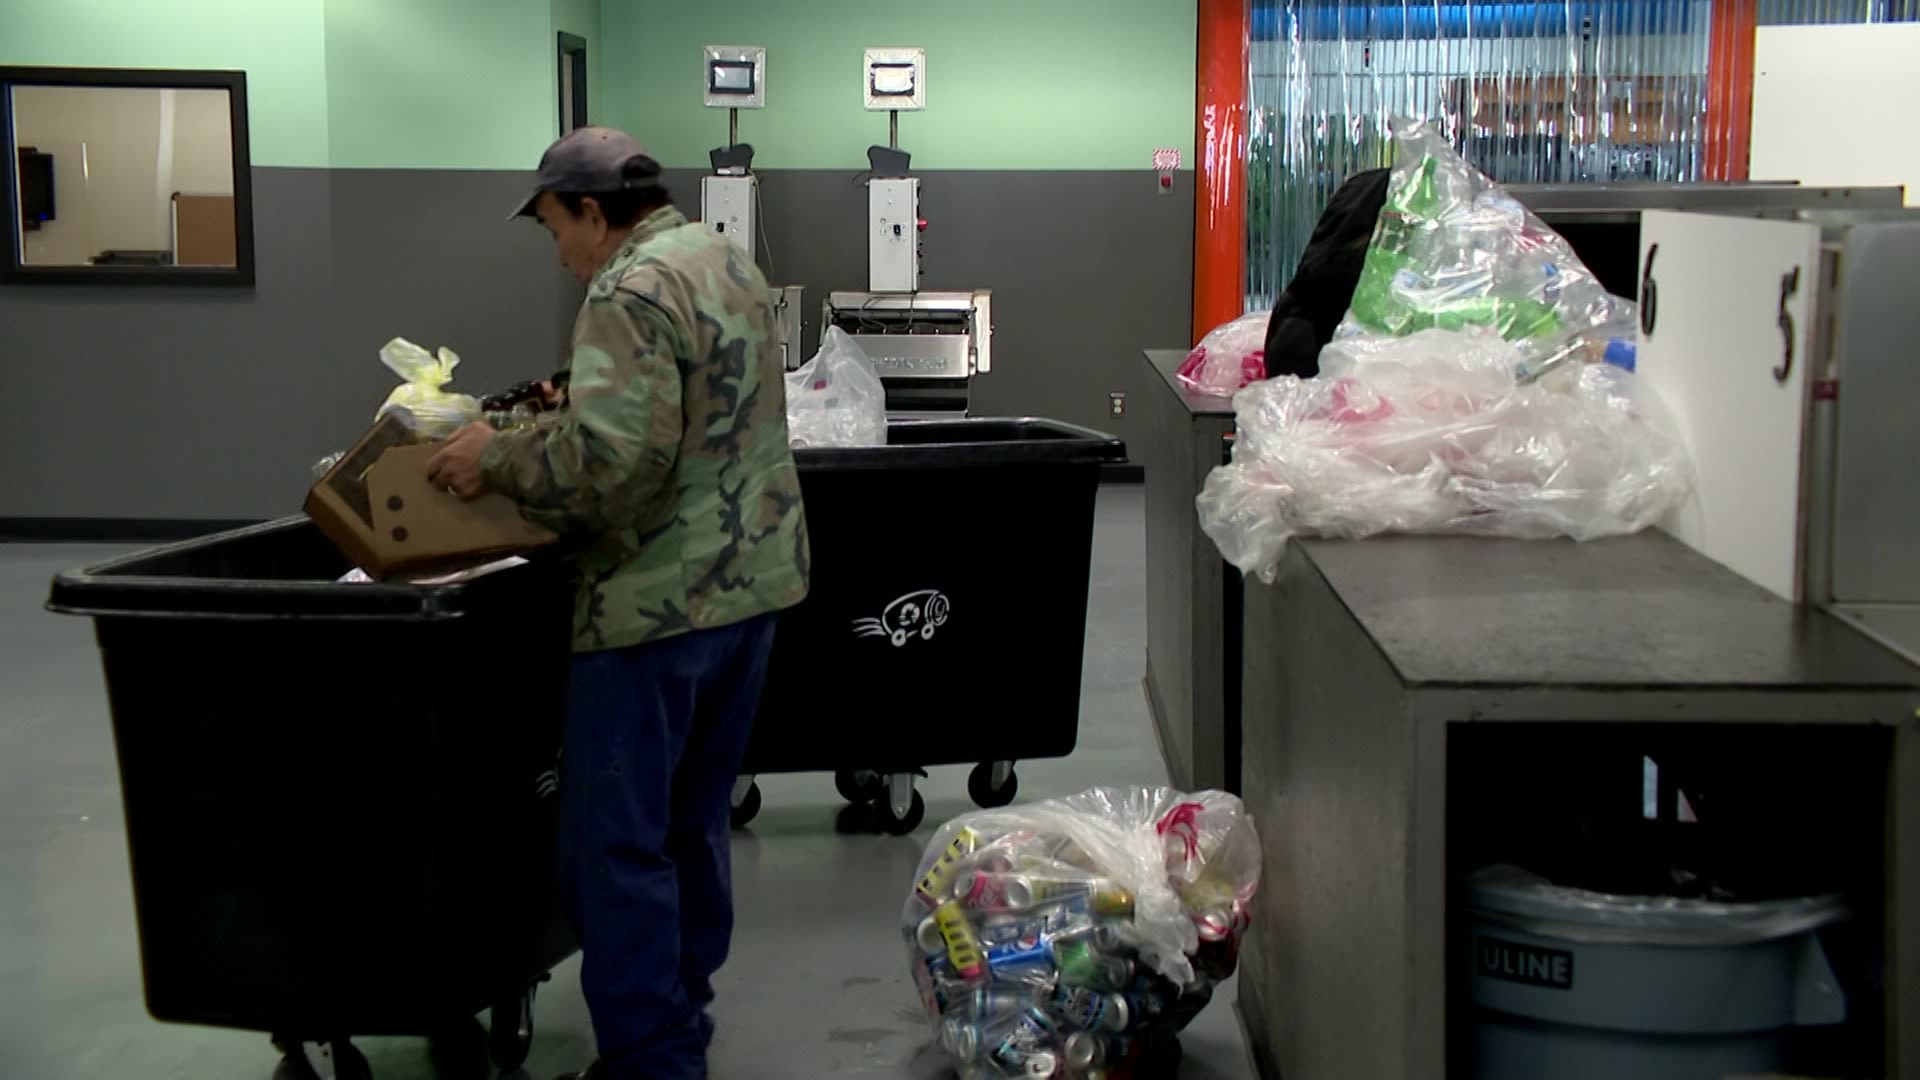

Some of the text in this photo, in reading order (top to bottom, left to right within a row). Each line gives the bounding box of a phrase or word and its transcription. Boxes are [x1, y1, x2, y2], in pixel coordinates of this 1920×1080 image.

[1641, 244, 1658, 336] 6
[1774, 265, 1800, 382] 5
[1484, 947, 1569, 982] ULINE
